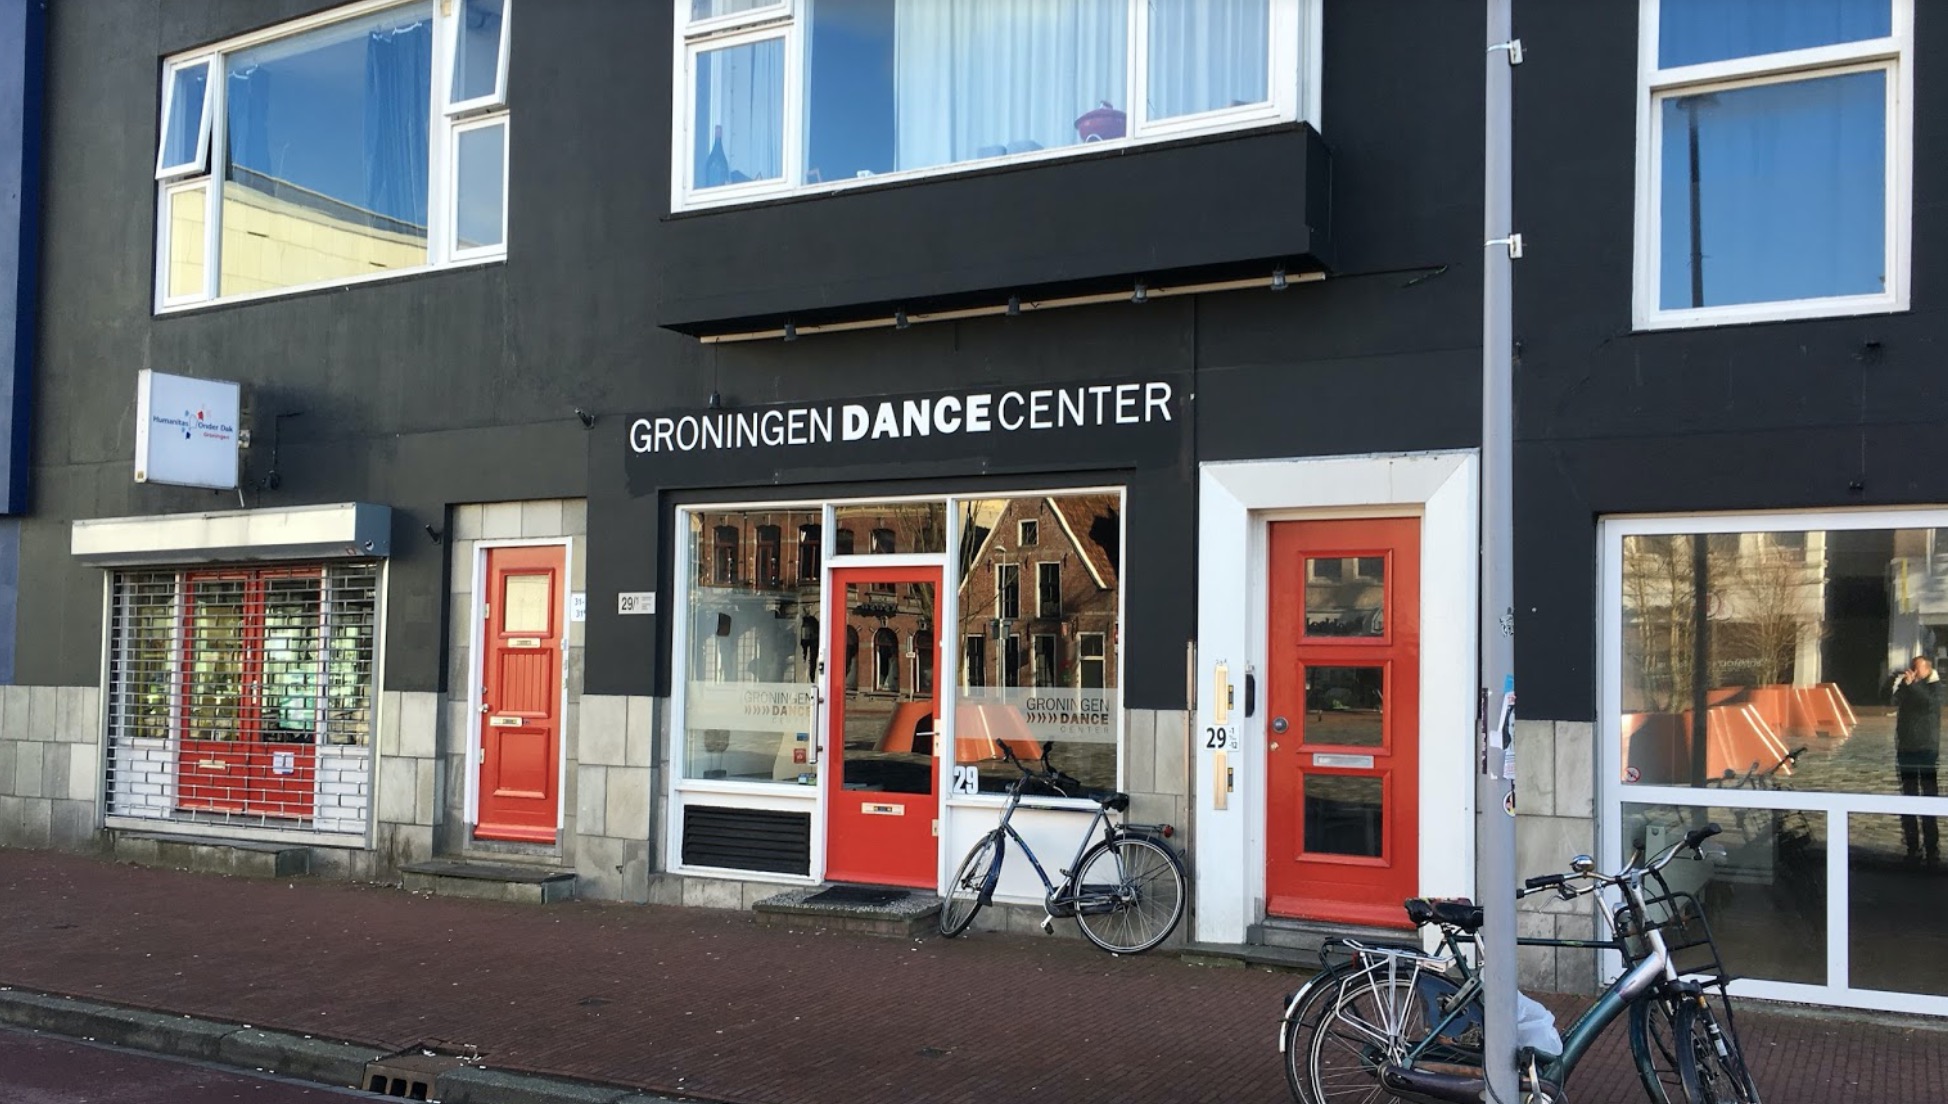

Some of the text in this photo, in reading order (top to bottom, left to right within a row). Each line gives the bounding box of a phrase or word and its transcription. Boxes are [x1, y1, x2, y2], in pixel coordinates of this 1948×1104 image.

[153, 415, 233, 432] Humanitas Onder Dak
[629, 381, 1173, 453] GRONINGEN DANCE CENTER
[1026, 697, 1109, 712] GRONINGEN
[1060, 713, 1109, 725] DANCE
[1060, 726, 1109, 734] CENTER
[1206, 727, 1227, 749] 29
[953, 766, 979, 794] 29
